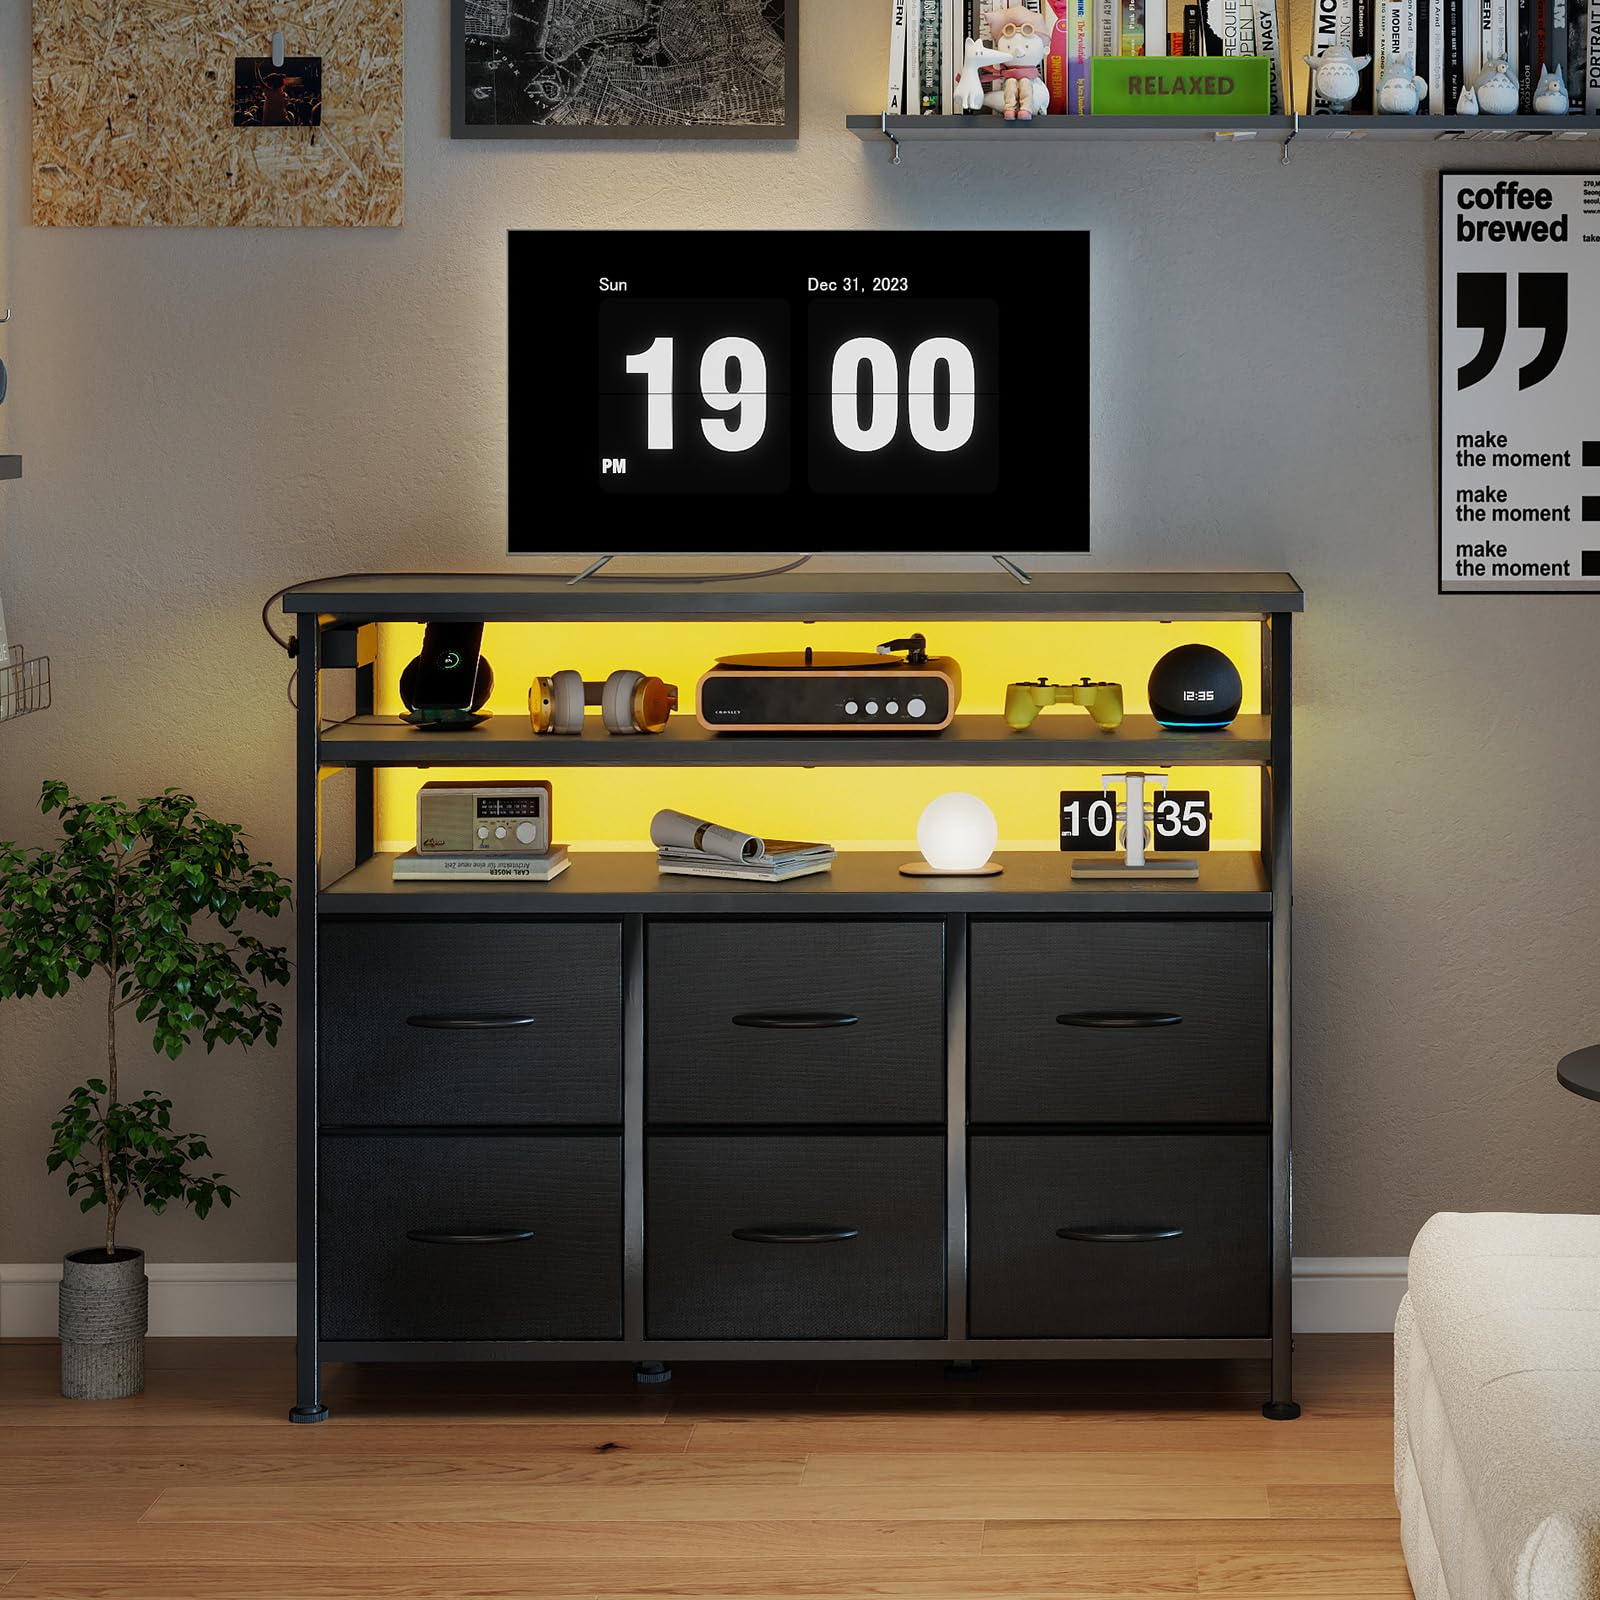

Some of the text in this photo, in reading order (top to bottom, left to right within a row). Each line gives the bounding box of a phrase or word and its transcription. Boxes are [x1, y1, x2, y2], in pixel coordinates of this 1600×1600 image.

[1260, 11, 1274, 51] NAGY
[1392, 9, 1400, 54] MODERN
[1077, 33, 1086, 64] Revolution
[1589, 11, 1598, 89] PORTRAIT
[1051, 55, 1062, 85] FLEMING
[1128, 75, 1235, 96] RELAXED
[1457, 181, 1553, 210] coffee
[1456, 213, 1568, 242] brewed
[599, 277, 628, 292] Sun
[807, 277, 909, 294] Dec 31, 2023
[625, 336, 976, 452] 19 00
[1456, 430, 1508, 448] make
[602, 458, 627, 474] PM
[1456, 449, 1571, 467] the moment
[1456, 485, 1508, 503] make
[1456, 504, 1571, 522] the moment
[1456, 540, 1508, 557] make
[1456, 559, 1571, 576] the moment
[1183, 691, 1215, 701] 12:35
[1063, 800, 1207, 837] 10 35
